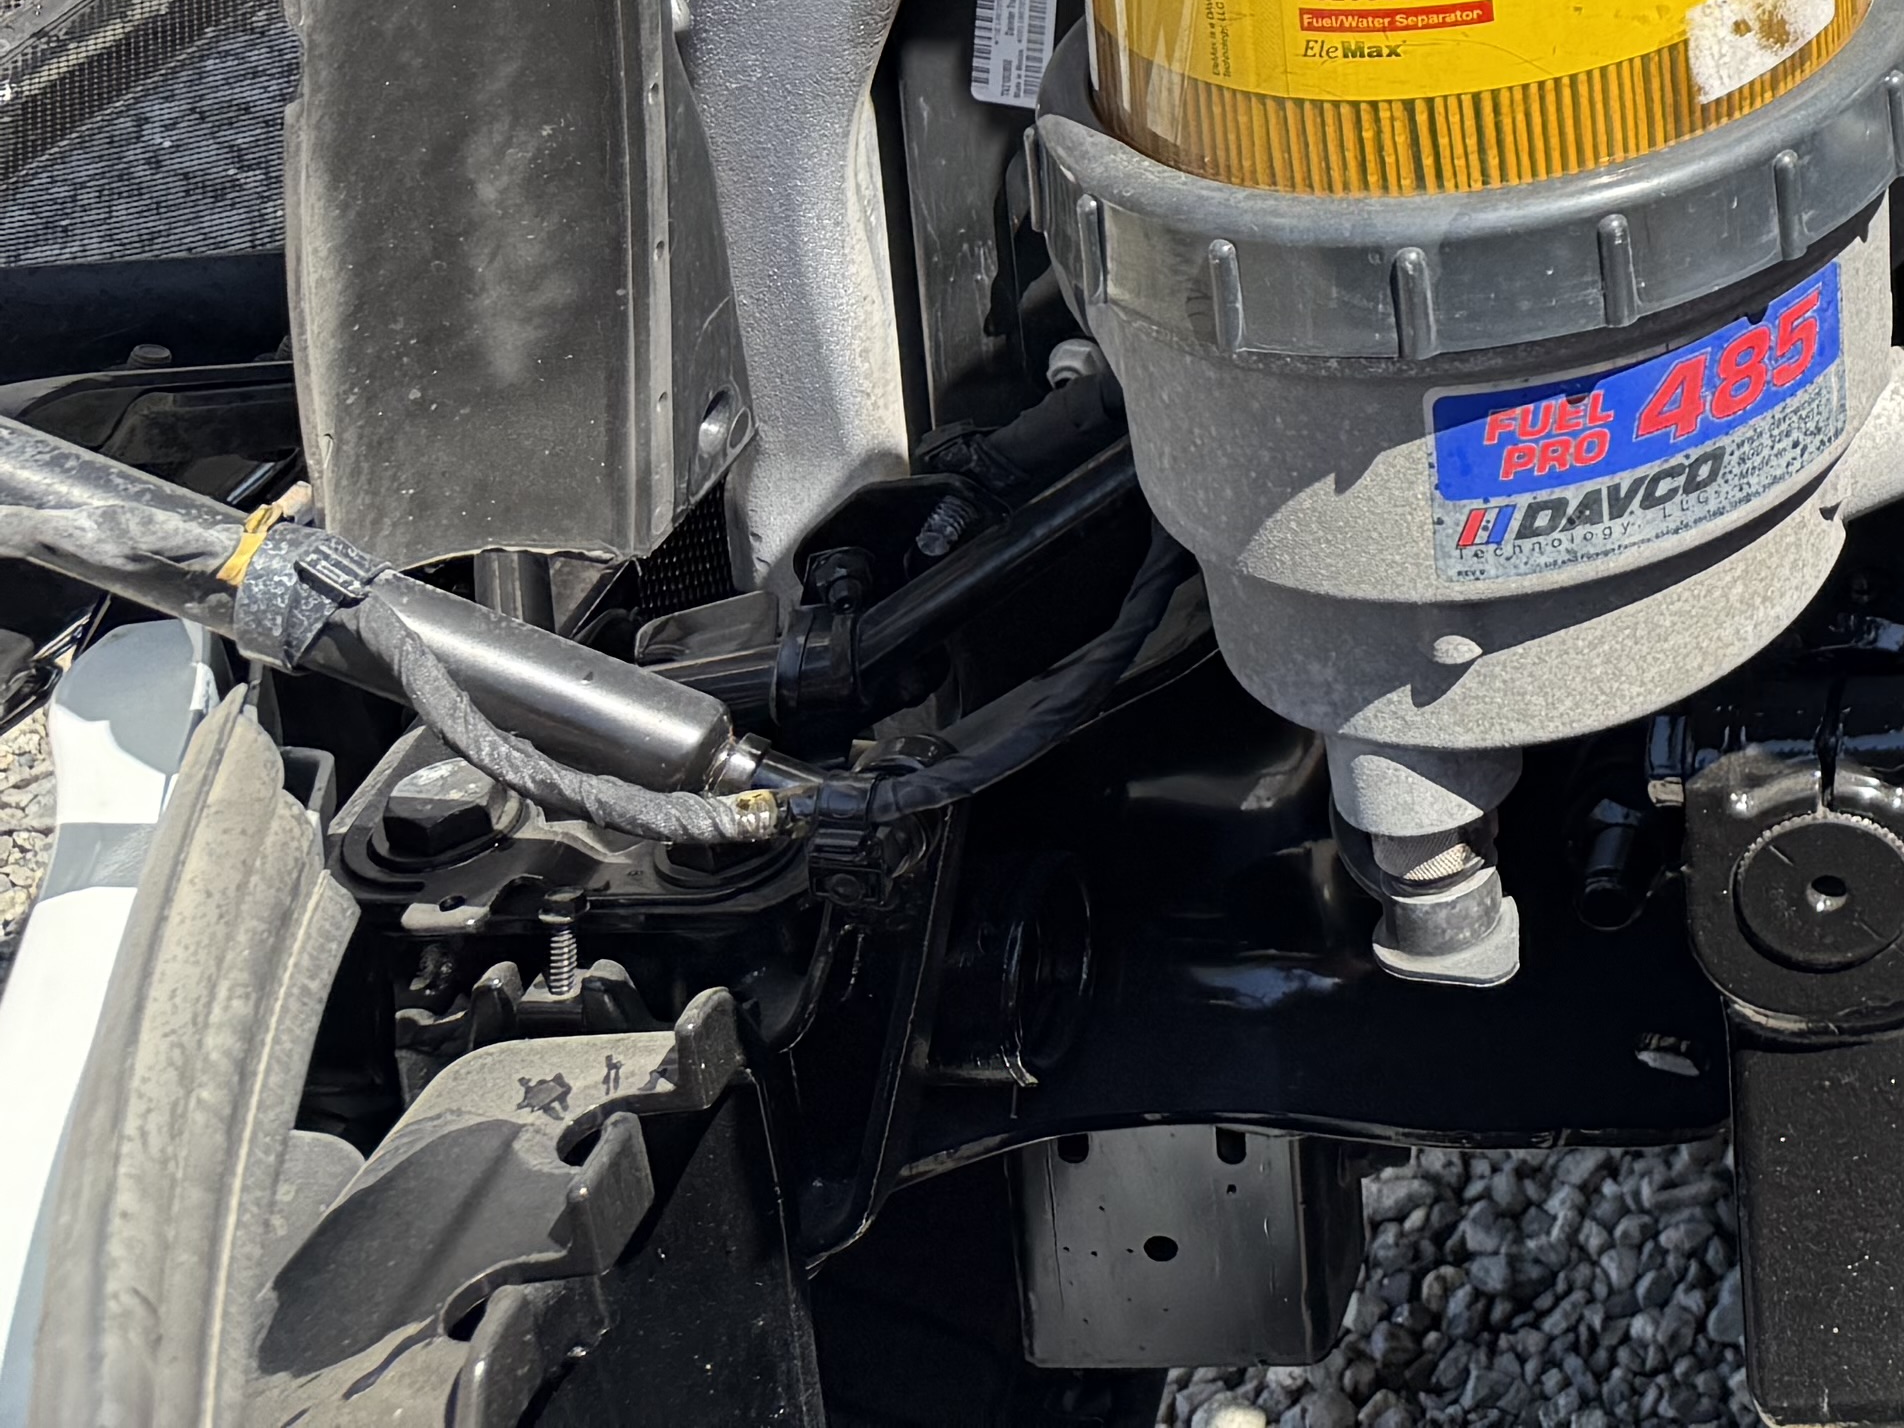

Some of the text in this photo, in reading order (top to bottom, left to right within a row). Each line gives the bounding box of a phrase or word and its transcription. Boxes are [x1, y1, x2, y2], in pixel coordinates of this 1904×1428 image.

[1302, 7, 1483, 29] Fuel/Water Separator
[1303, 39, 1402, 59] EleMax
[1632, 282, 1822, 443] 485
[1483, 390, 1615, 446] FUEL
[1499, 432, 1612, 481] PRO
[1513, 446, 1727, 541] DAVCO
[1661, 489, 1711, 520] LLC
